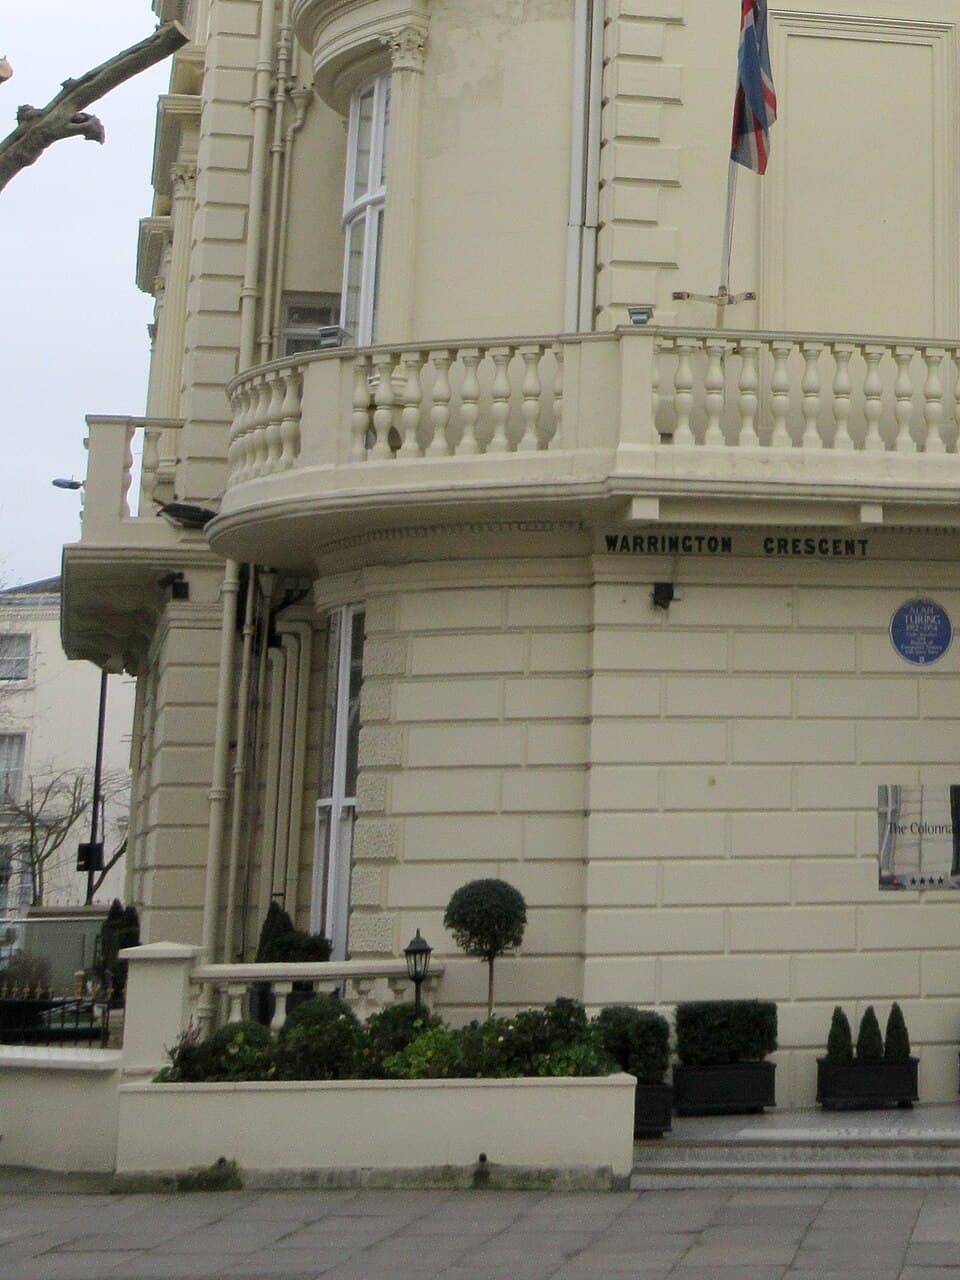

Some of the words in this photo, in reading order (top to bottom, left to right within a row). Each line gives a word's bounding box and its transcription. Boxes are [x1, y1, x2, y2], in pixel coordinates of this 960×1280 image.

[605, 534, 733, 553] WARRINGTON
[763, 537, 870, 556] CRESCENT
[905, 615, 941, 625] TURING
[889, 822, 906, 834] The
